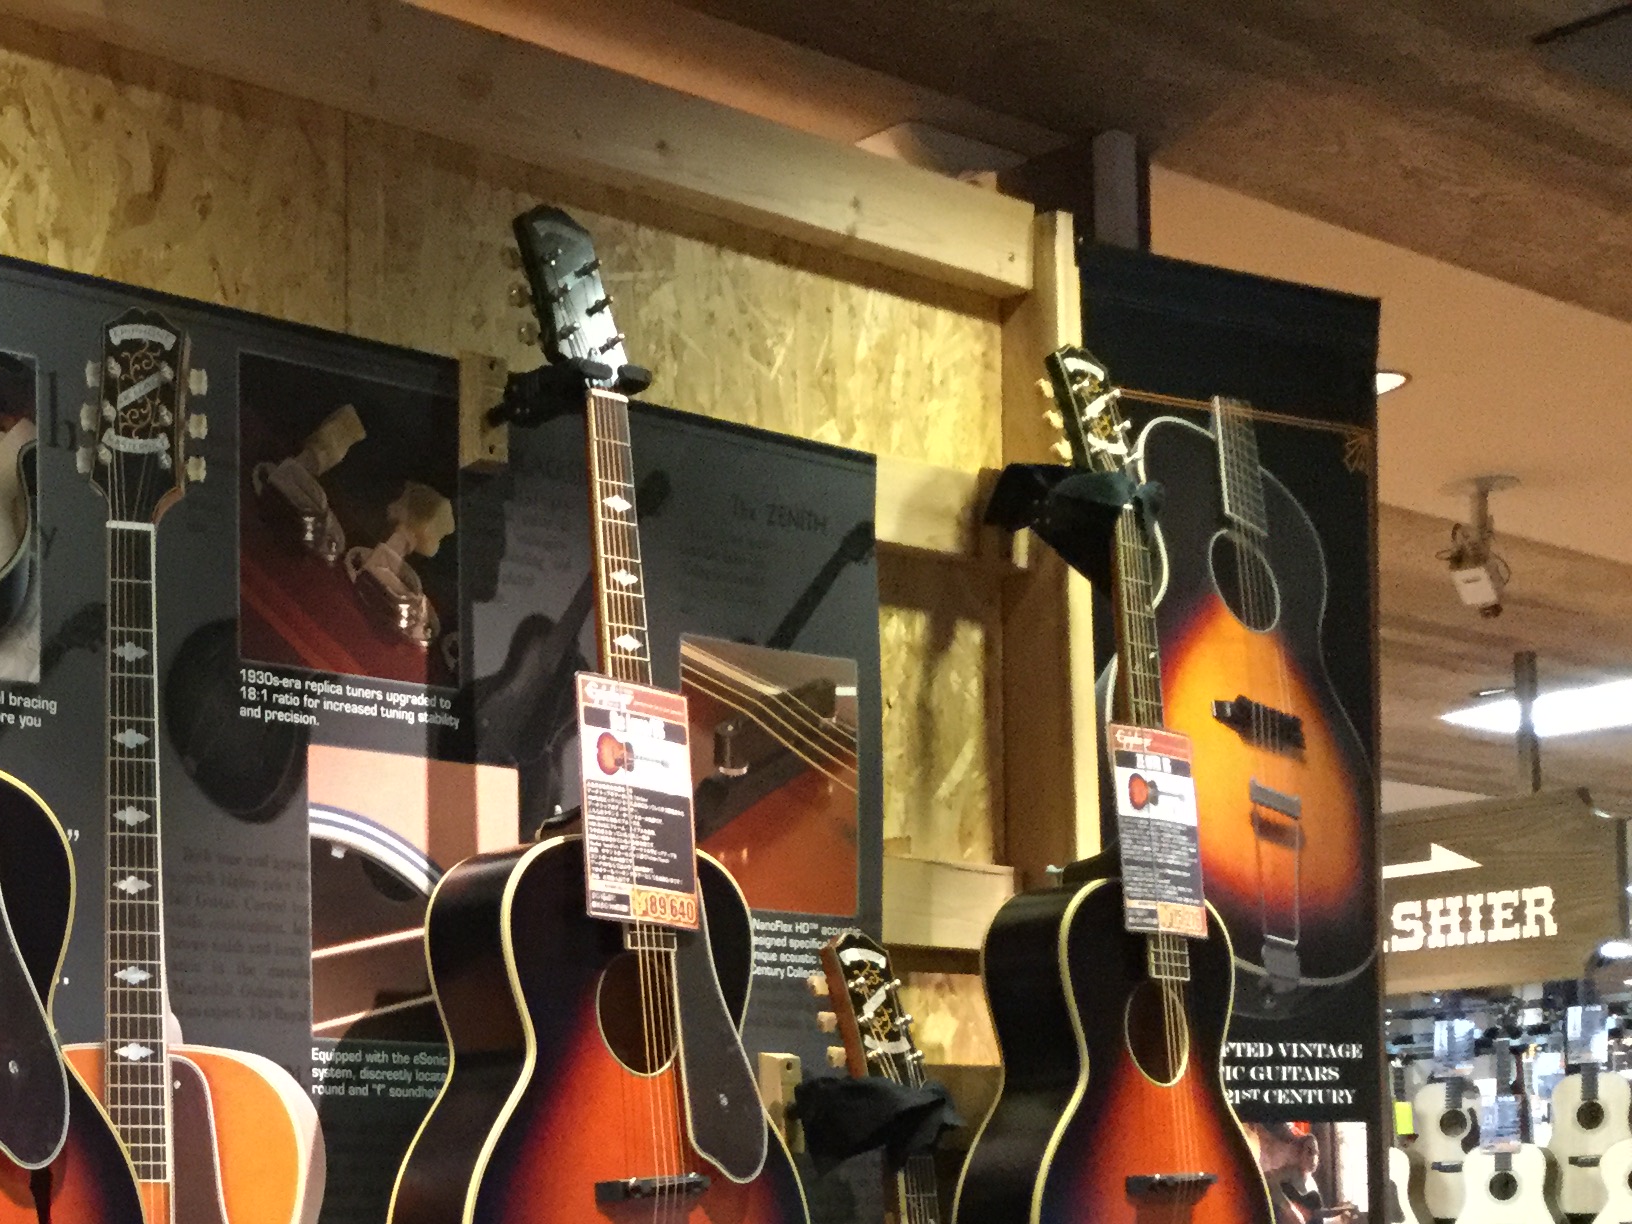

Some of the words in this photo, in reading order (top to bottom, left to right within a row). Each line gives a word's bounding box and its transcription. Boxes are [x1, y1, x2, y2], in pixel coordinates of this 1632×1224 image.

[239, 667, 302, 691] 1930s-era
[304, 676, 344, 698] replica
[346, 683, 384, 702] tuners
[386, 689, 437, 710] upgraded
[439, 696, 452, 711] to
[8, 693, 59, 711] bracing
[239, 685, 268, 704] 18:1
[272, 690, 301, 708] ratio
[303, 693, 320, 710] for
[323, 696, 378, 718] increased
[380, 705, 416, 725] tuning
[418, 710, 461, 730] stability
[19, 712, 43, 728] you
[239, 704, 262, 720] and
[264, 707, 321, 728] precision.
[1383, 884, 1559, 954] SHIER
[310, 1046, 363, 1069] Equipped
[365, 1048, 390, 1066] with
[392, 1050, 411, 1066] the
[1279, 1042, 1364, 1060] VINTAGE
[310, 1066, 357, 1085] system,
[359, 1068, 413, 1087] discreetly
[1249, 1065, 1341, 1082] GUITARS
[310, 1083, 347, 1098] round
[348, 1083, 370, 1098] and
[1263, 1088, 1356, 1105] CENTURY
